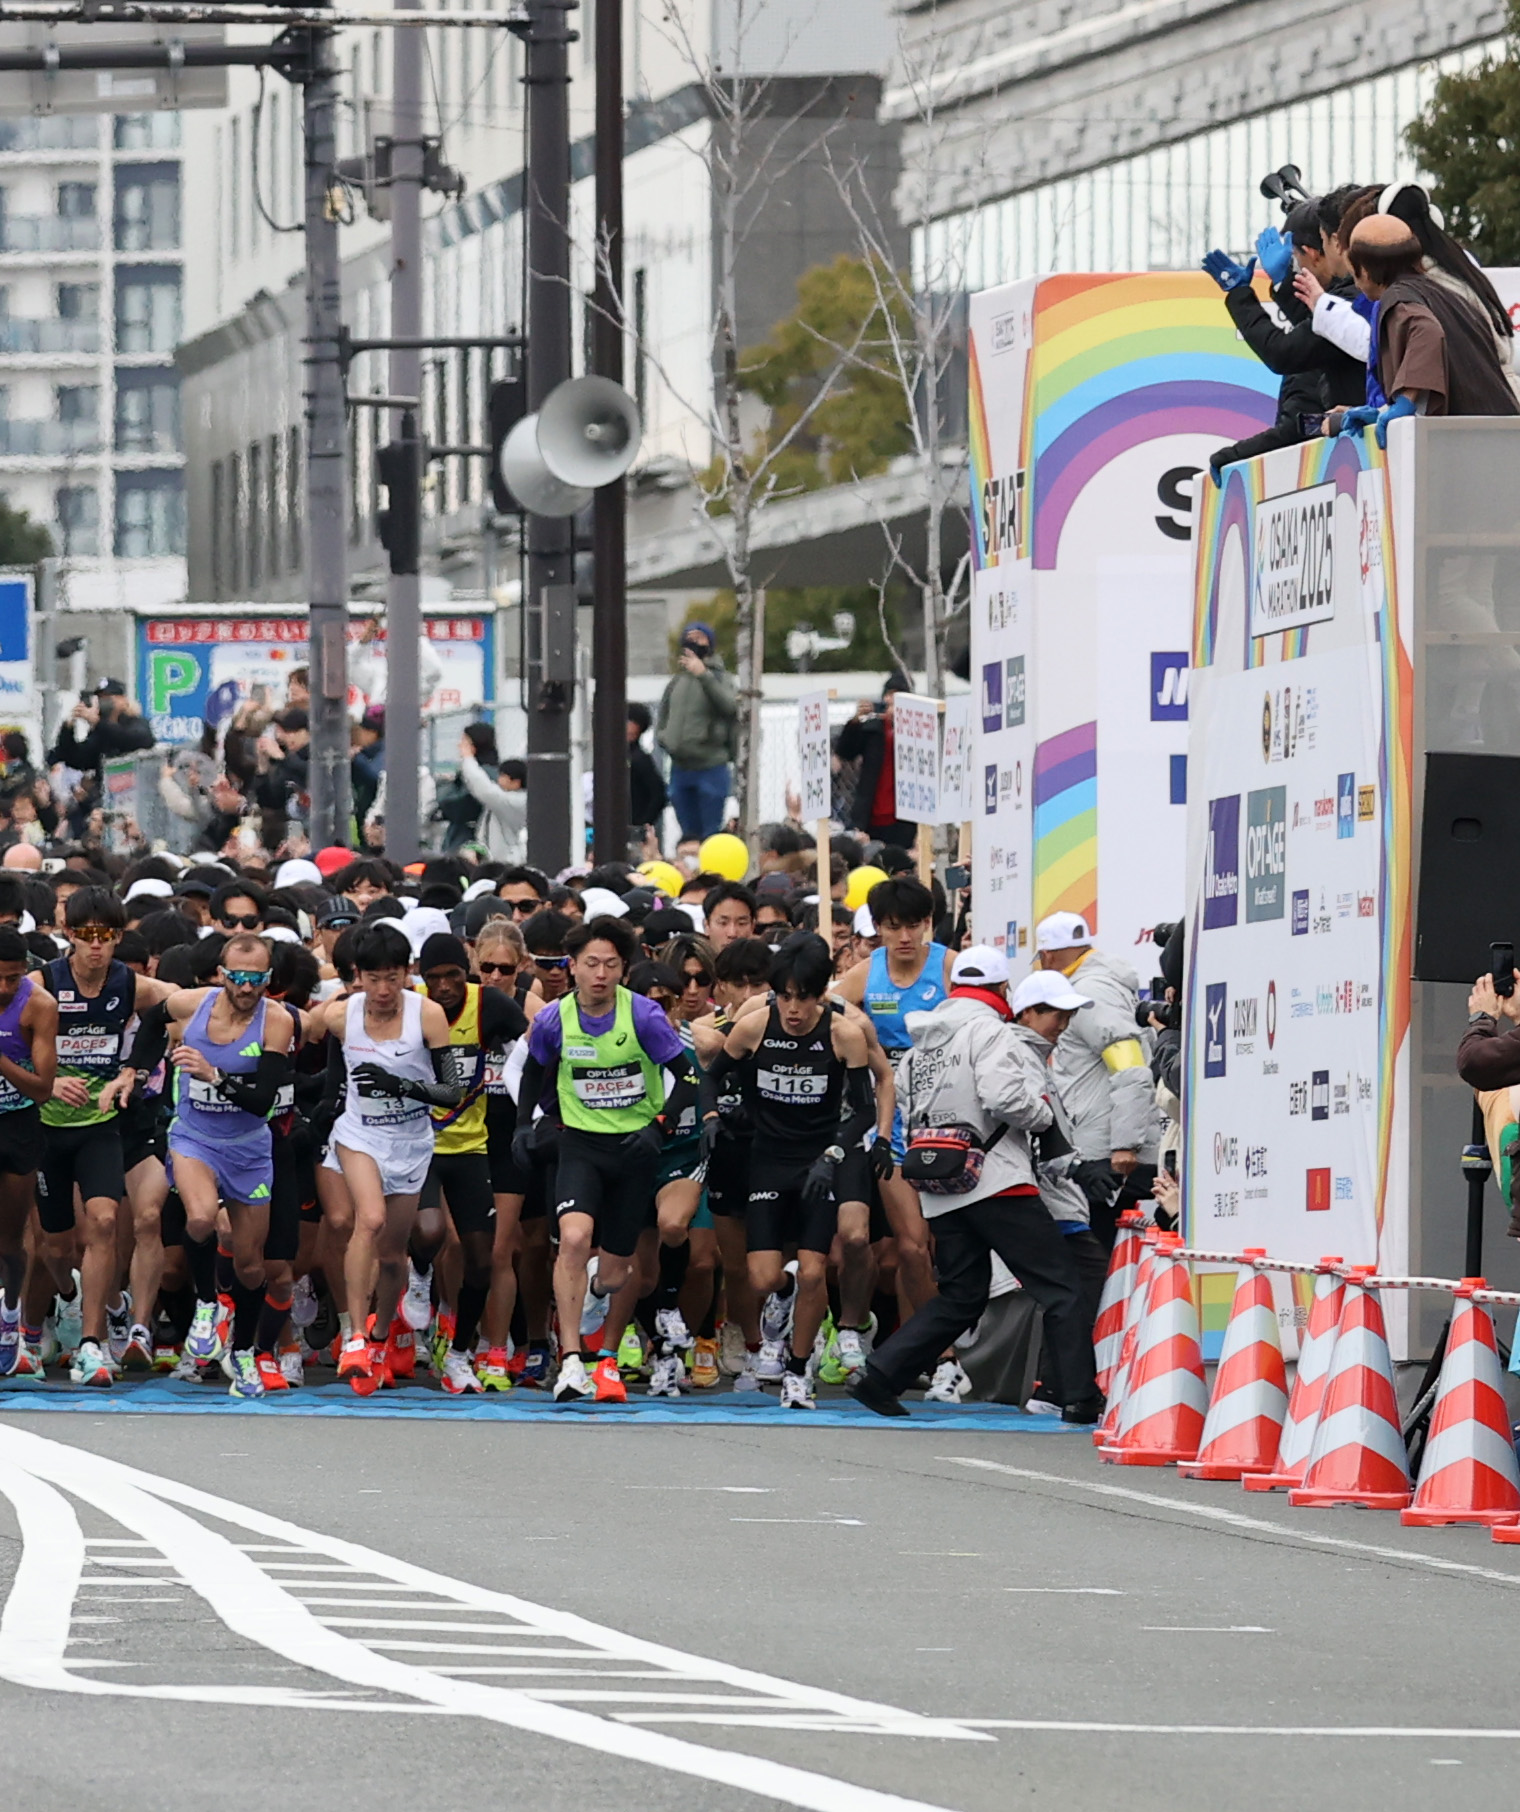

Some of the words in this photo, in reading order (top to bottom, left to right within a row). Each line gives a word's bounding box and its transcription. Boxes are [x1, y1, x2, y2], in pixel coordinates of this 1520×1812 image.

[984, 471, 1025, 558] START
[1269, 506, 1299, 572] OSAKA
[1299, 500, 1334, 611] 2025
[1267, 577, 1299, 620] MARATHON
[152, 649, 203, 717] P
[1247, 822, 1284, 878] OPTAGE
[68, 1026, 107, 1035] OPTAGE
[61, 1038, 107, 1050] PACE5
[348, 1045, 376, 1053] HONDA
[763, 1039, 798, 1050] GMO
[84, 1055, 111, 1065] Metro
[913, 1048, 944, 1071] SAKA
[587, 1068, 628, 1079] OPTAGE
[772, 1064, 813, 1075] OPTAGE
[770, 1077, 814, 1094] 116
[761, 1089, 790, 1103] Osaka
[791, 1095, 821, 1104] Metro
[193, 1101, 223, 1113] Osaka
[382, 1100, 405, 1111] 13
[584, 1098, 612, 1109] Osaka
[365, 1113, 394, 1125] Osaka
[933, 1111, 957, 1123] EXPO
[749, 1190, 779, 1201] GMO
